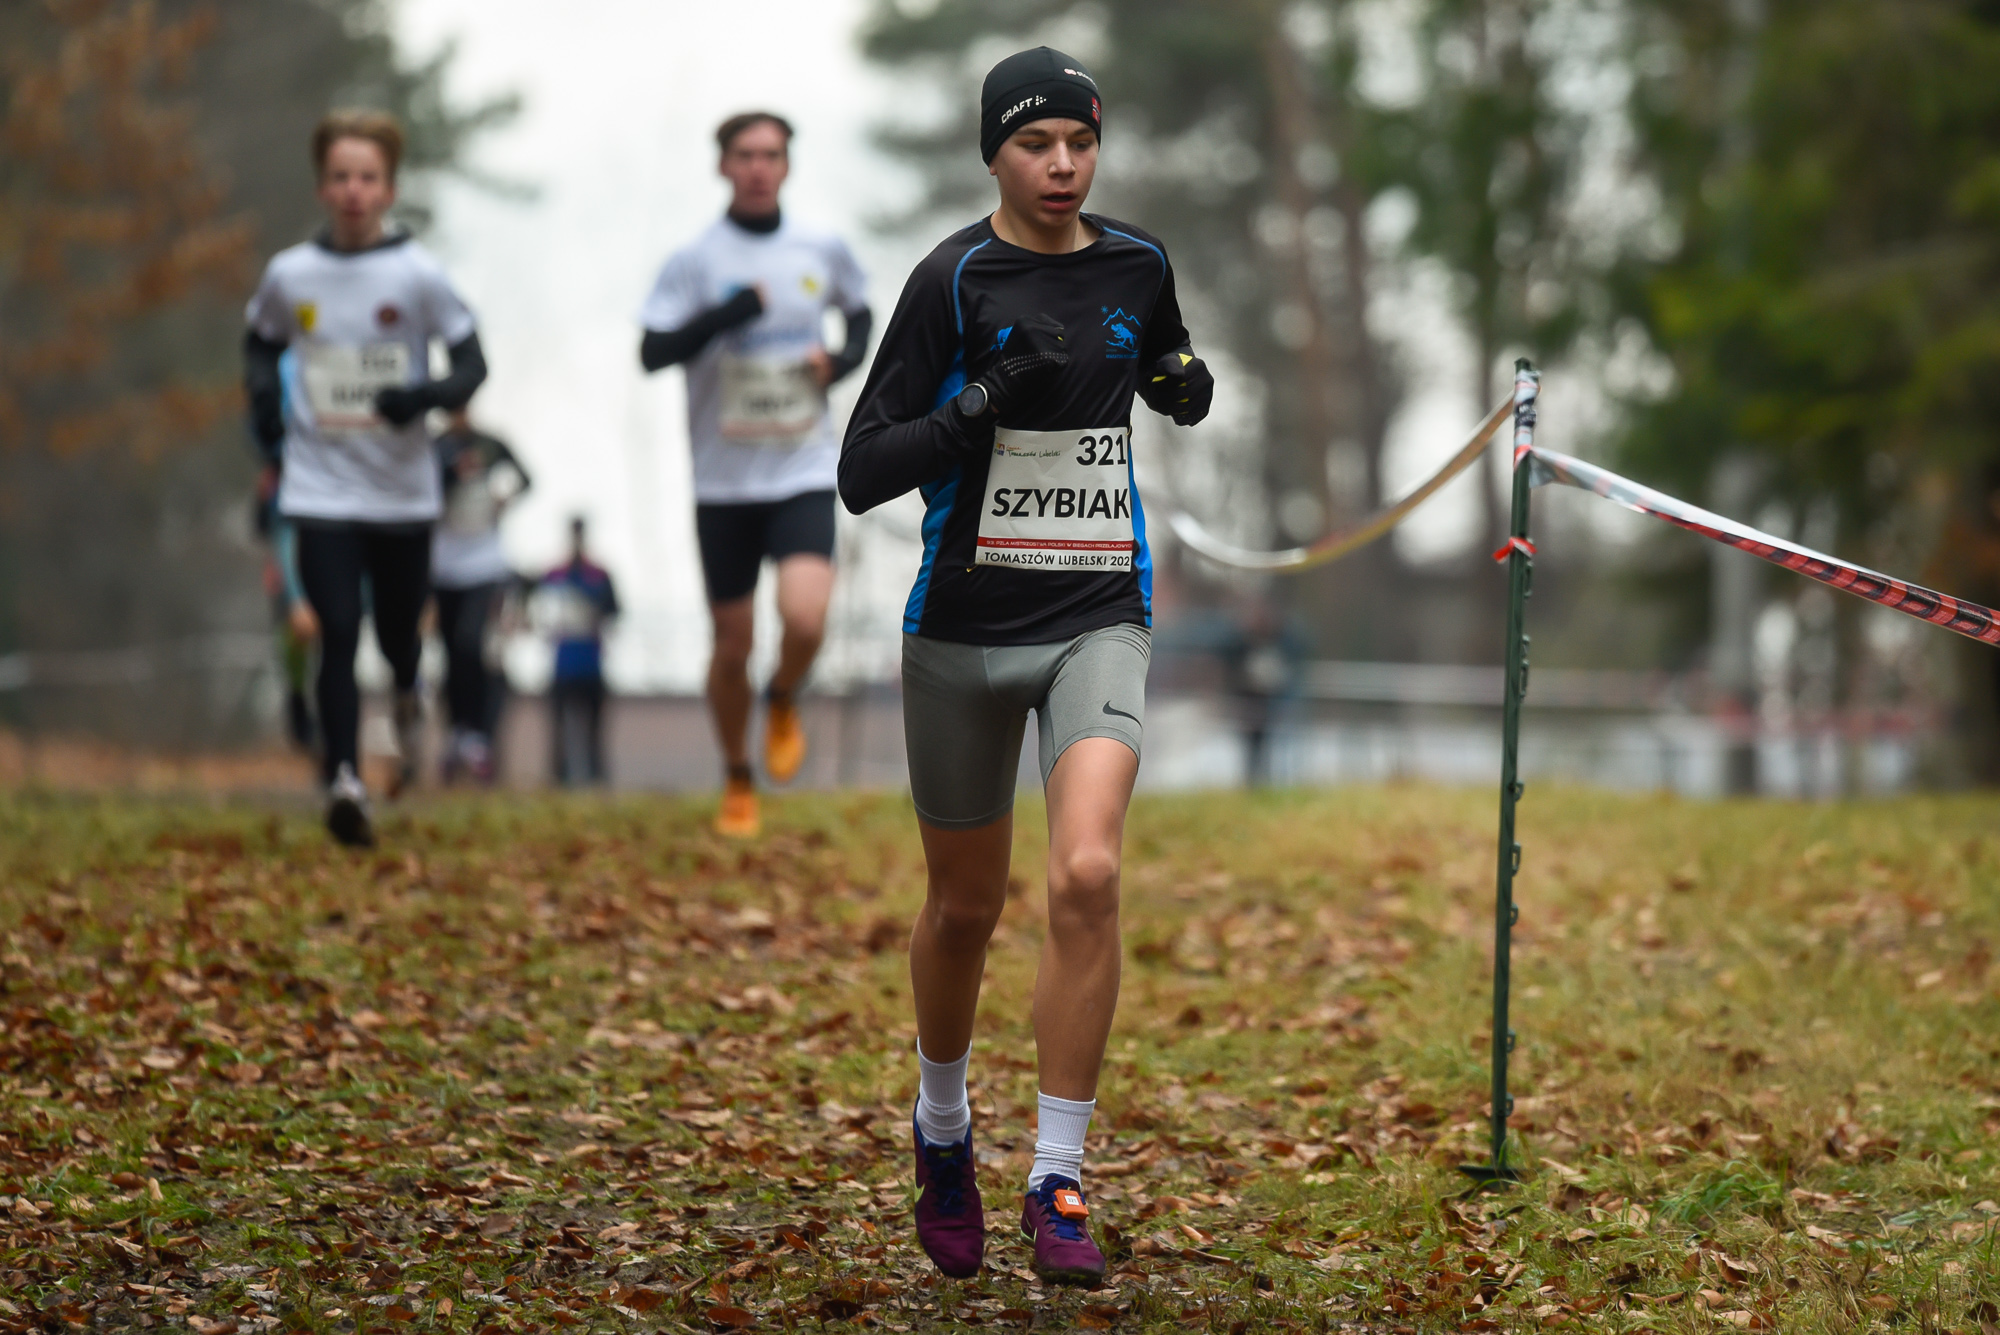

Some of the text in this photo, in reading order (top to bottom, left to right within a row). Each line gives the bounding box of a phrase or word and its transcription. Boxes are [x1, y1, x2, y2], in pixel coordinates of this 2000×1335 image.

[1001, 97, 1033, 124] CRAFT
[1076, 434, 1126, 466] 321
[991, 488, 1130, 519] SZYBIAK
[985, 551, 1055, 565] TOMASZÓW
[1058, 555, 1107, 566] LUBELSKI
